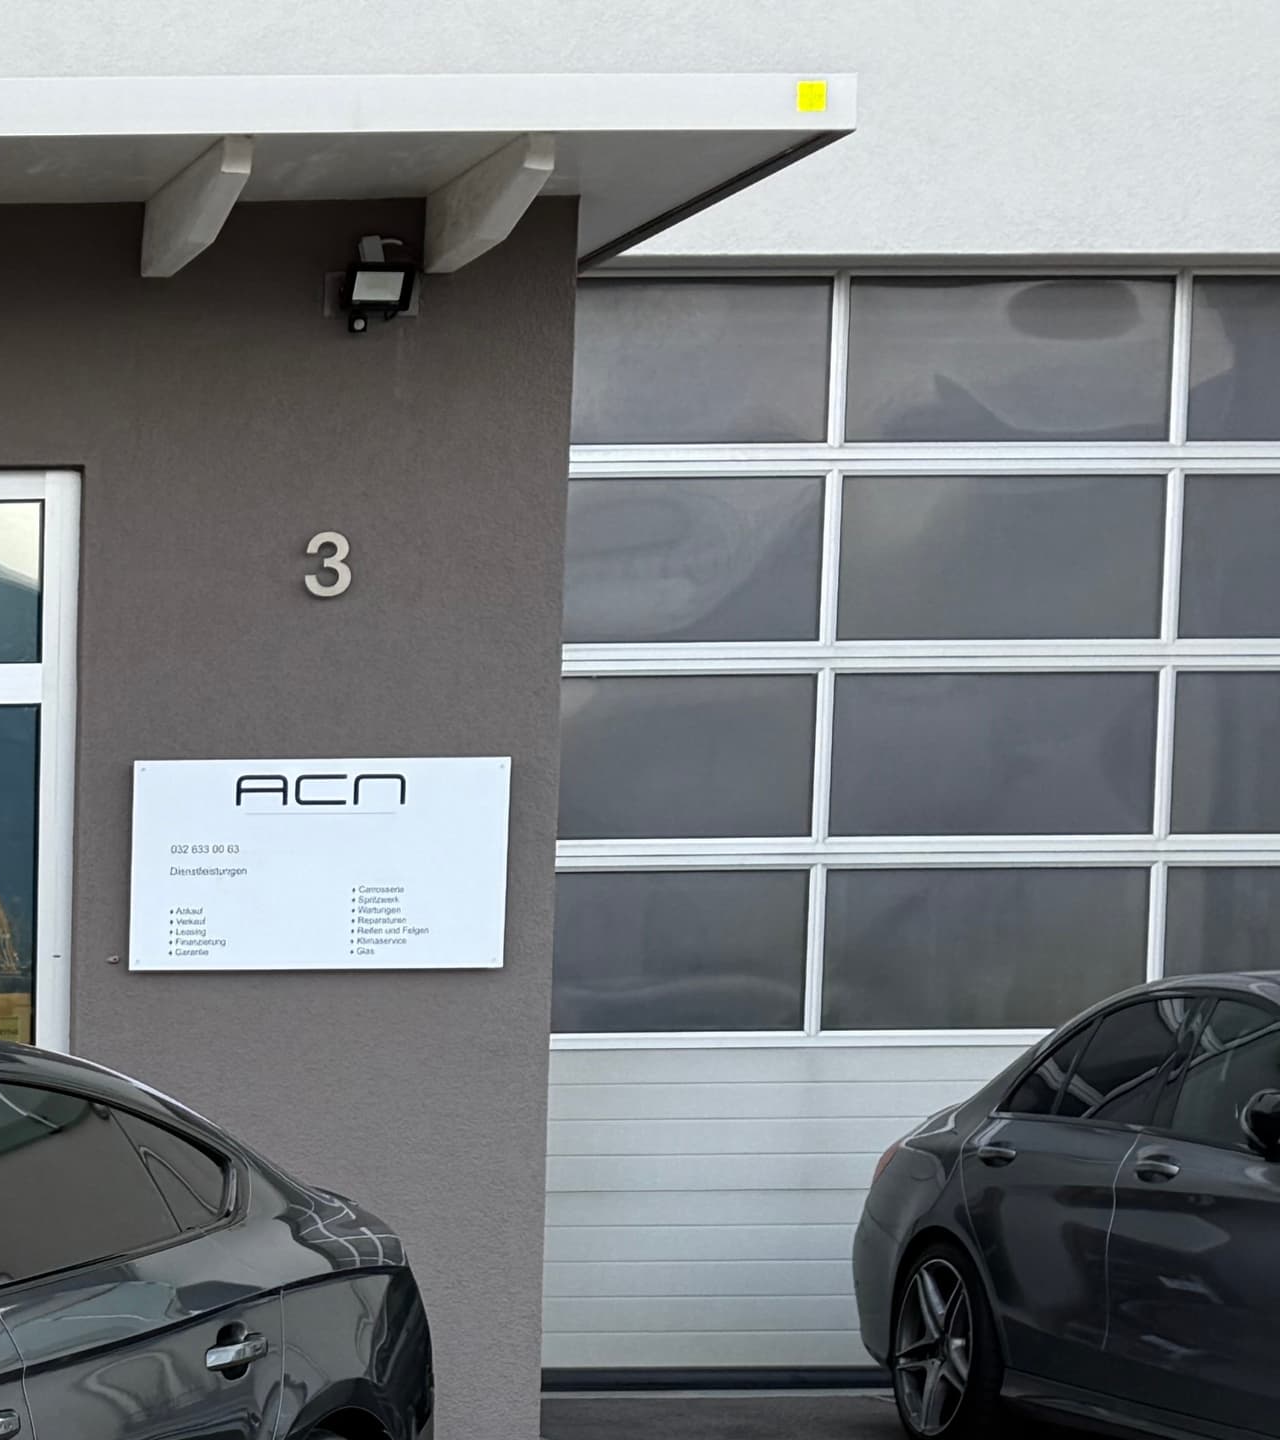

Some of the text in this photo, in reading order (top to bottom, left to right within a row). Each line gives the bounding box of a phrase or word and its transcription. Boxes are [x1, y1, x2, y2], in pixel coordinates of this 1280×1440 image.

[305, 531, 351, 597] 3
[236, 774, 406, 806] ACN
[170, 845, 189, 854] 032
[212, 845, 224, 854] 00
[170, 867, 247, 877] Dienstleistungen
[176, 907, 203, 915] Ankauf
[358, 906, 401, 915] Wartungen
[176, 917, 206, 925] Verkauf
[357, 916, 407, 925] Reparaturen
[175, 928, 206, 937] Leasing
[402, 927, 429, 935] Felgen
[175, 938, 226, 947] Finanzierung
[356, 937, 407, 945] Klimaservice
